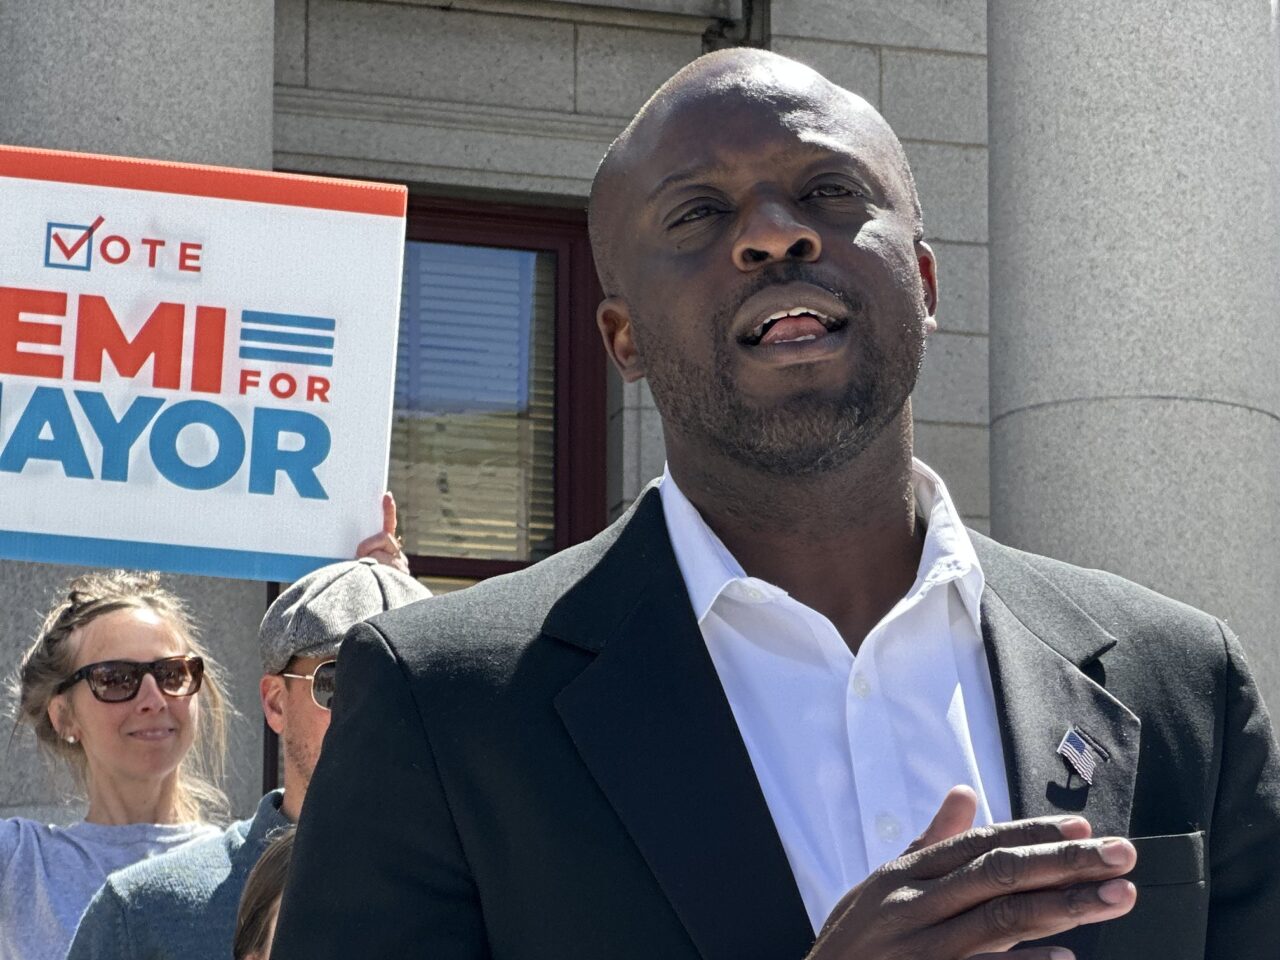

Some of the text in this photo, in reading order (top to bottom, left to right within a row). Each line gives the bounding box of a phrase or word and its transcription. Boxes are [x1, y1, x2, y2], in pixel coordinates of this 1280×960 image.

[0, 286, 227, 395] EMI
[238, 369, 332, 403] FOR
[0, 381, 332, 500] AYOR
